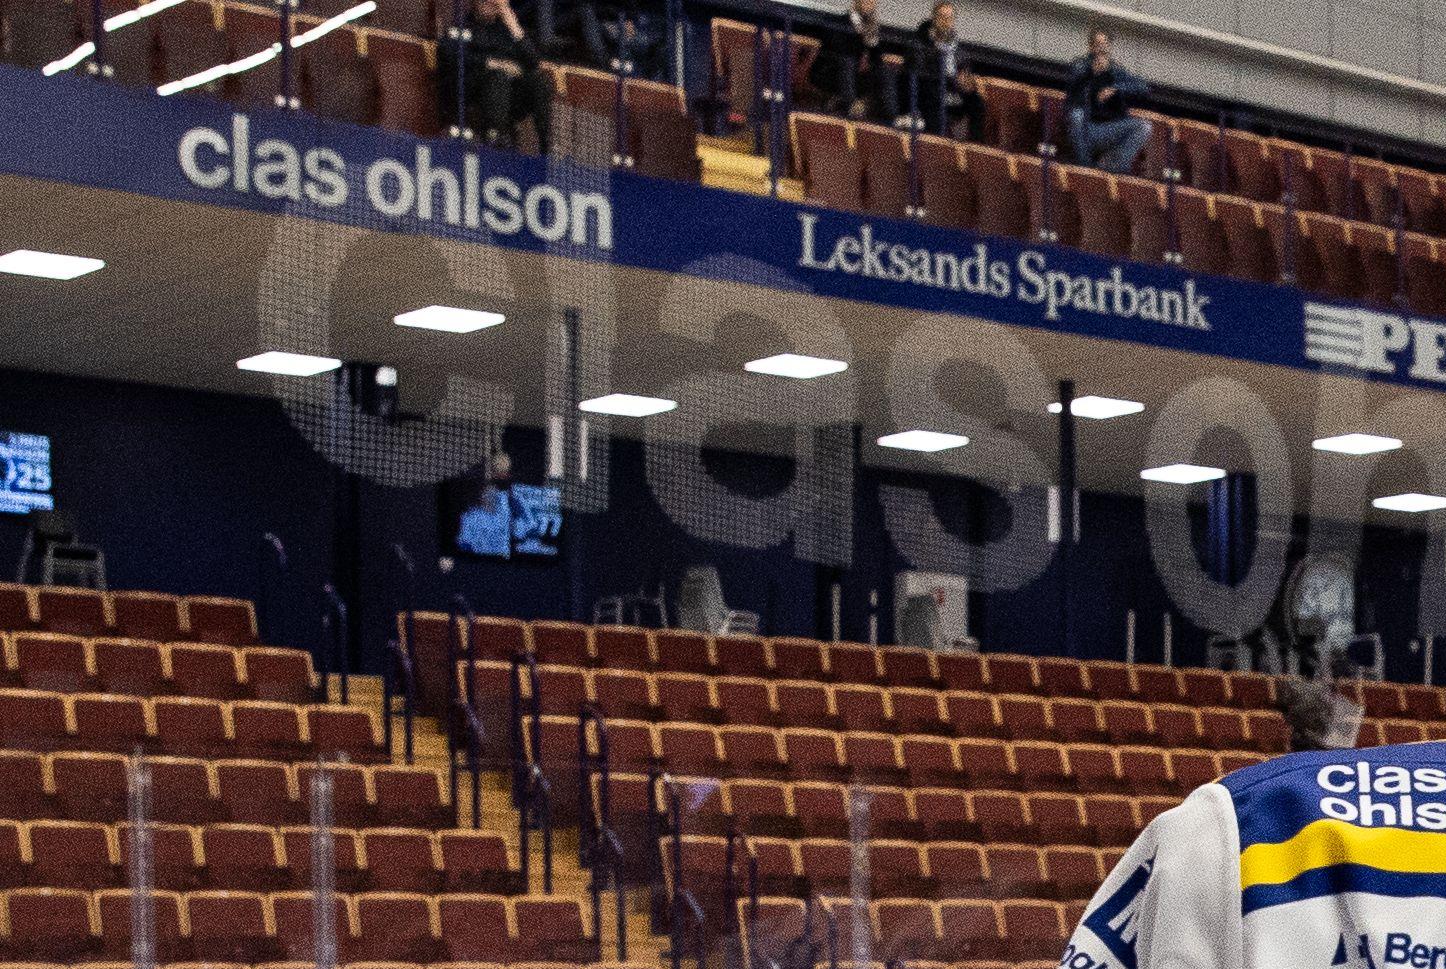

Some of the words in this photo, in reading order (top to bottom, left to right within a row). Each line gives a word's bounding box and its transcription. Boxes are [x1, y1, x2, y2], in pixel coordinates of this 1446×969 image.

[178, 114, 348, 206] clas
[366, 147, 614, 250] ohlson
[798, 214, 1011, 299] Leksands
[1018, 247, 1212, 332] Sparbank
